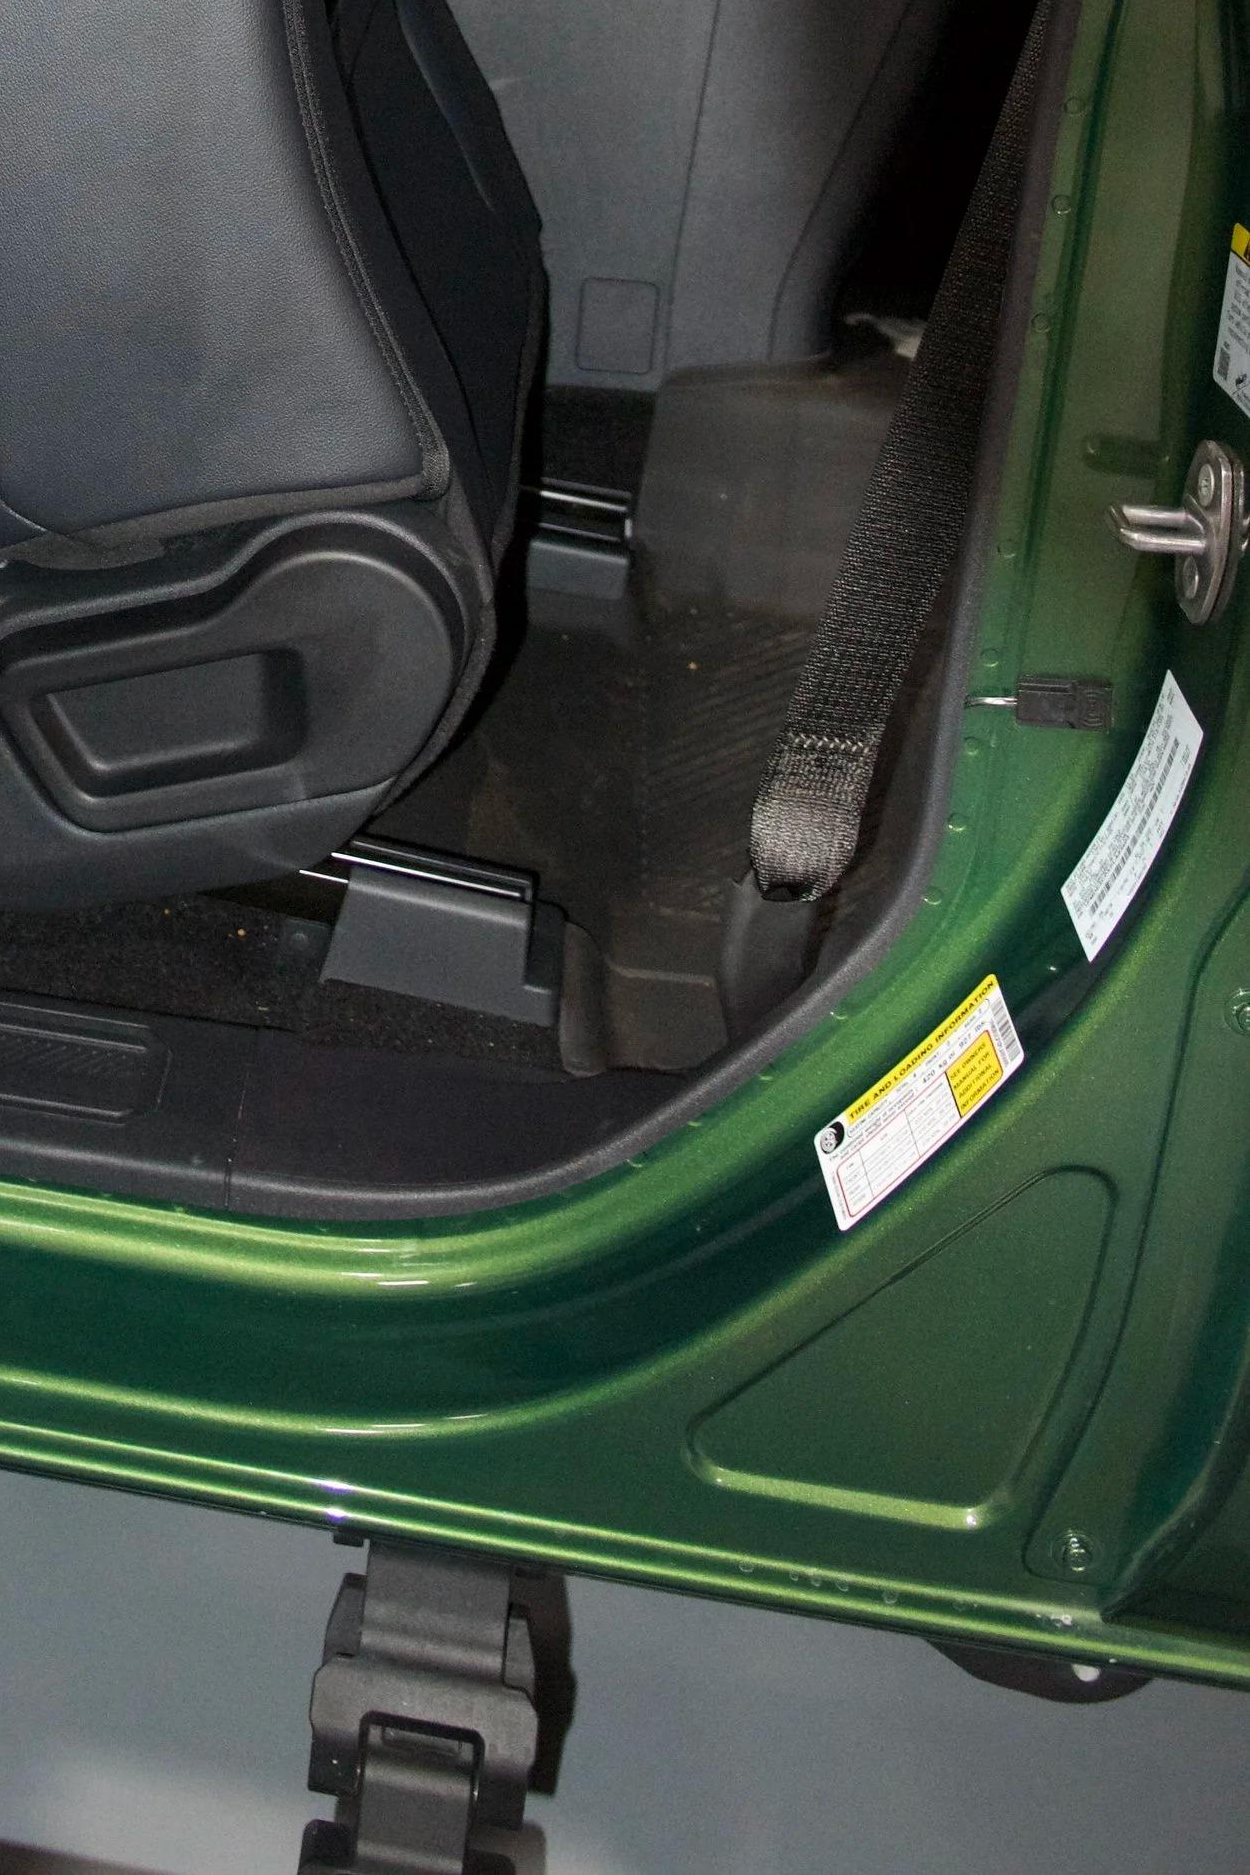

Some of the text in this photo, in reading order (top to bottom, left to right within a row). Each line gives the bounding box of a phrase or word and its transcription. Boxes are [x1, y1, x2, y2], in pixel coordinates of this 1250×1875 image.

[850, 1099, 870, 1119] TIRE
[873, 1081, 892, 1100] AND
[894, 1044, 933, 1081] LOADING
[935, 981, 994, 1043] INFORMATION
[951, 1042, 986, 1080] SEE OWNERS
[953, 1052, 990, 1089] MANUAL FOR
[958, 1064, 992, 1098] ADDITIONAL
[961, 1069, 1000, 1109] INFORMATION
